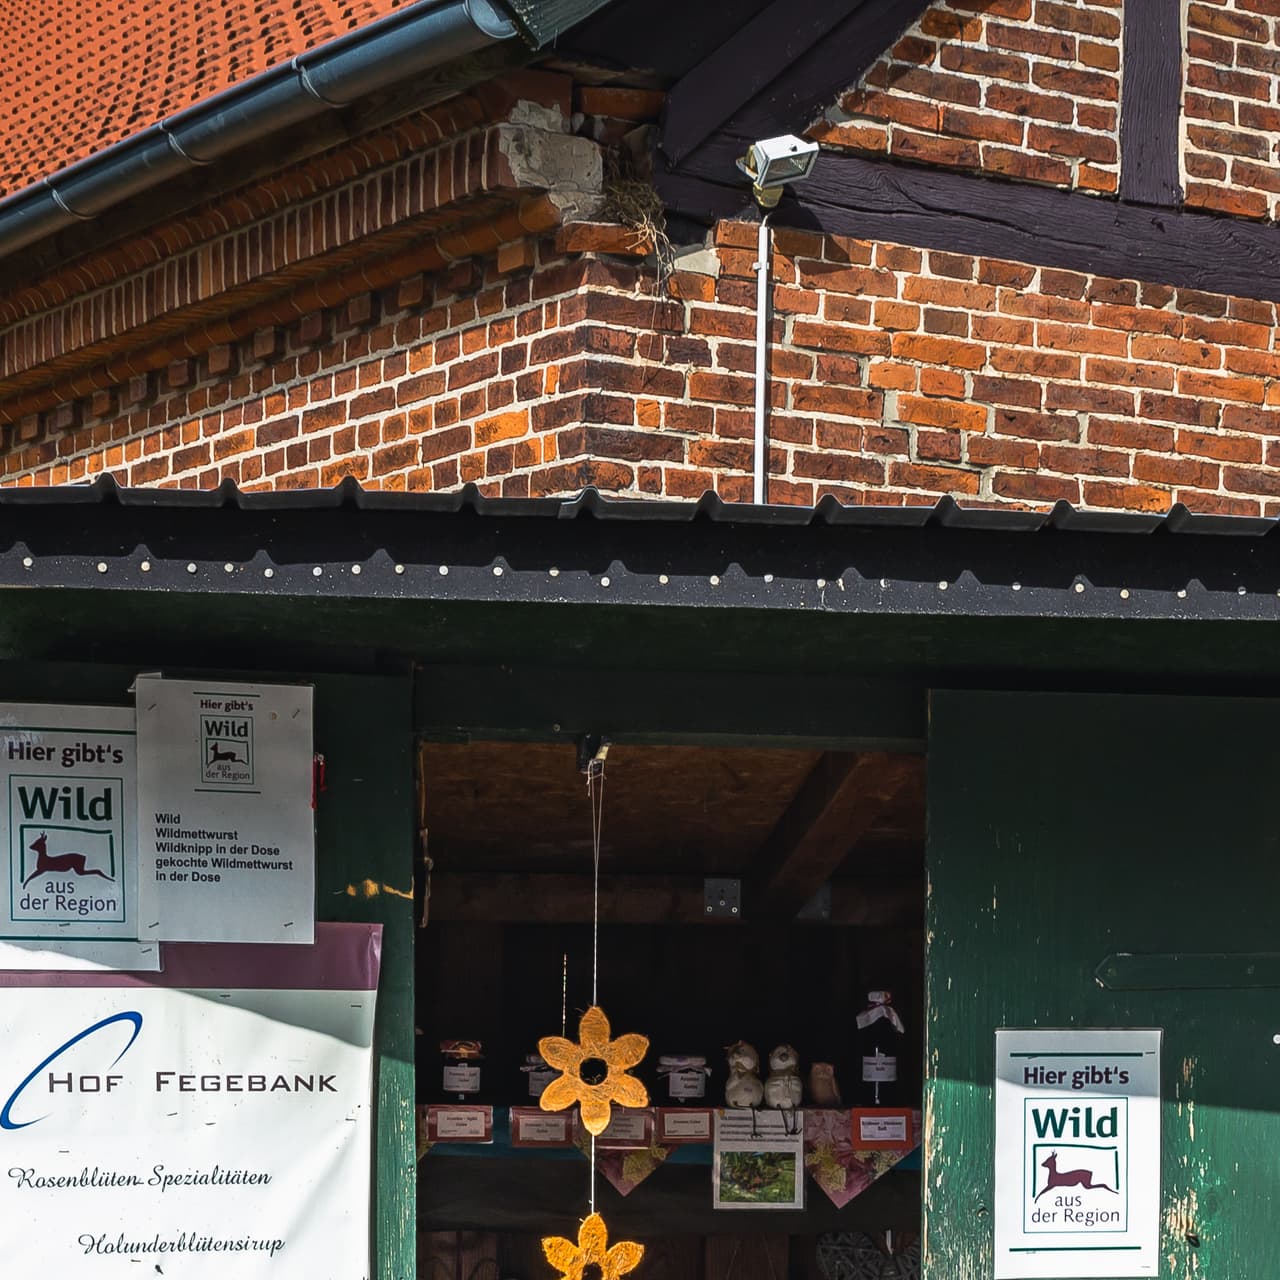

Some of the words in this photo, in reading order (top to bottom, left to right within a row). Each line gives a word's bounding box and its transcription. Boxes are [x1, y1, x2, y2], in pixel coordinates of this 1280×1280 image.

[200, 699, 222, 711] Hier
[205, 720, 248, 737] Wild
[8, 742, 55, 762] Hier
[206, 769, 219, 779] der
[222, 770, 250, 781] Region
[217, 764, 232, 772] aus
[18, 786, 113, 821] Wild
[155, 813, 180, 825] Wild
[155, 828, 238, 841] Wildmettwurst
[155, 843, 213, 856] Wildknipp
[216, 845, 226, 854] in
[230, 845, 249, 855] der
[252, 845, 280, 856] Dose
[155, 857, 208, 871] gekochte
[210, 858, 293, 871] Wildmettwurst
[155, 871, 165, 882] in
[168, 872, 188, 882] der
[191, 873, 221, 883] Dose
[45, 880, 75, 894] aus
[20, 895, 50, 912] der
[55, 895, 117, 915] Region
[48, 1072, 124, 1093] HOF
[156, 1071, 338, 1093] FEGEBANK
[1024, 1066, 1067, 1085] Hier
[1032, 1107, 1117, 1138] Wild
[1055, 1196, 1081, 1207] aus
[1032, 1208, 1057, 1223] der
[1064, 1208, 1120, 1226] Region
[78, 1232, 286, 1257] Holunderblütensirup
